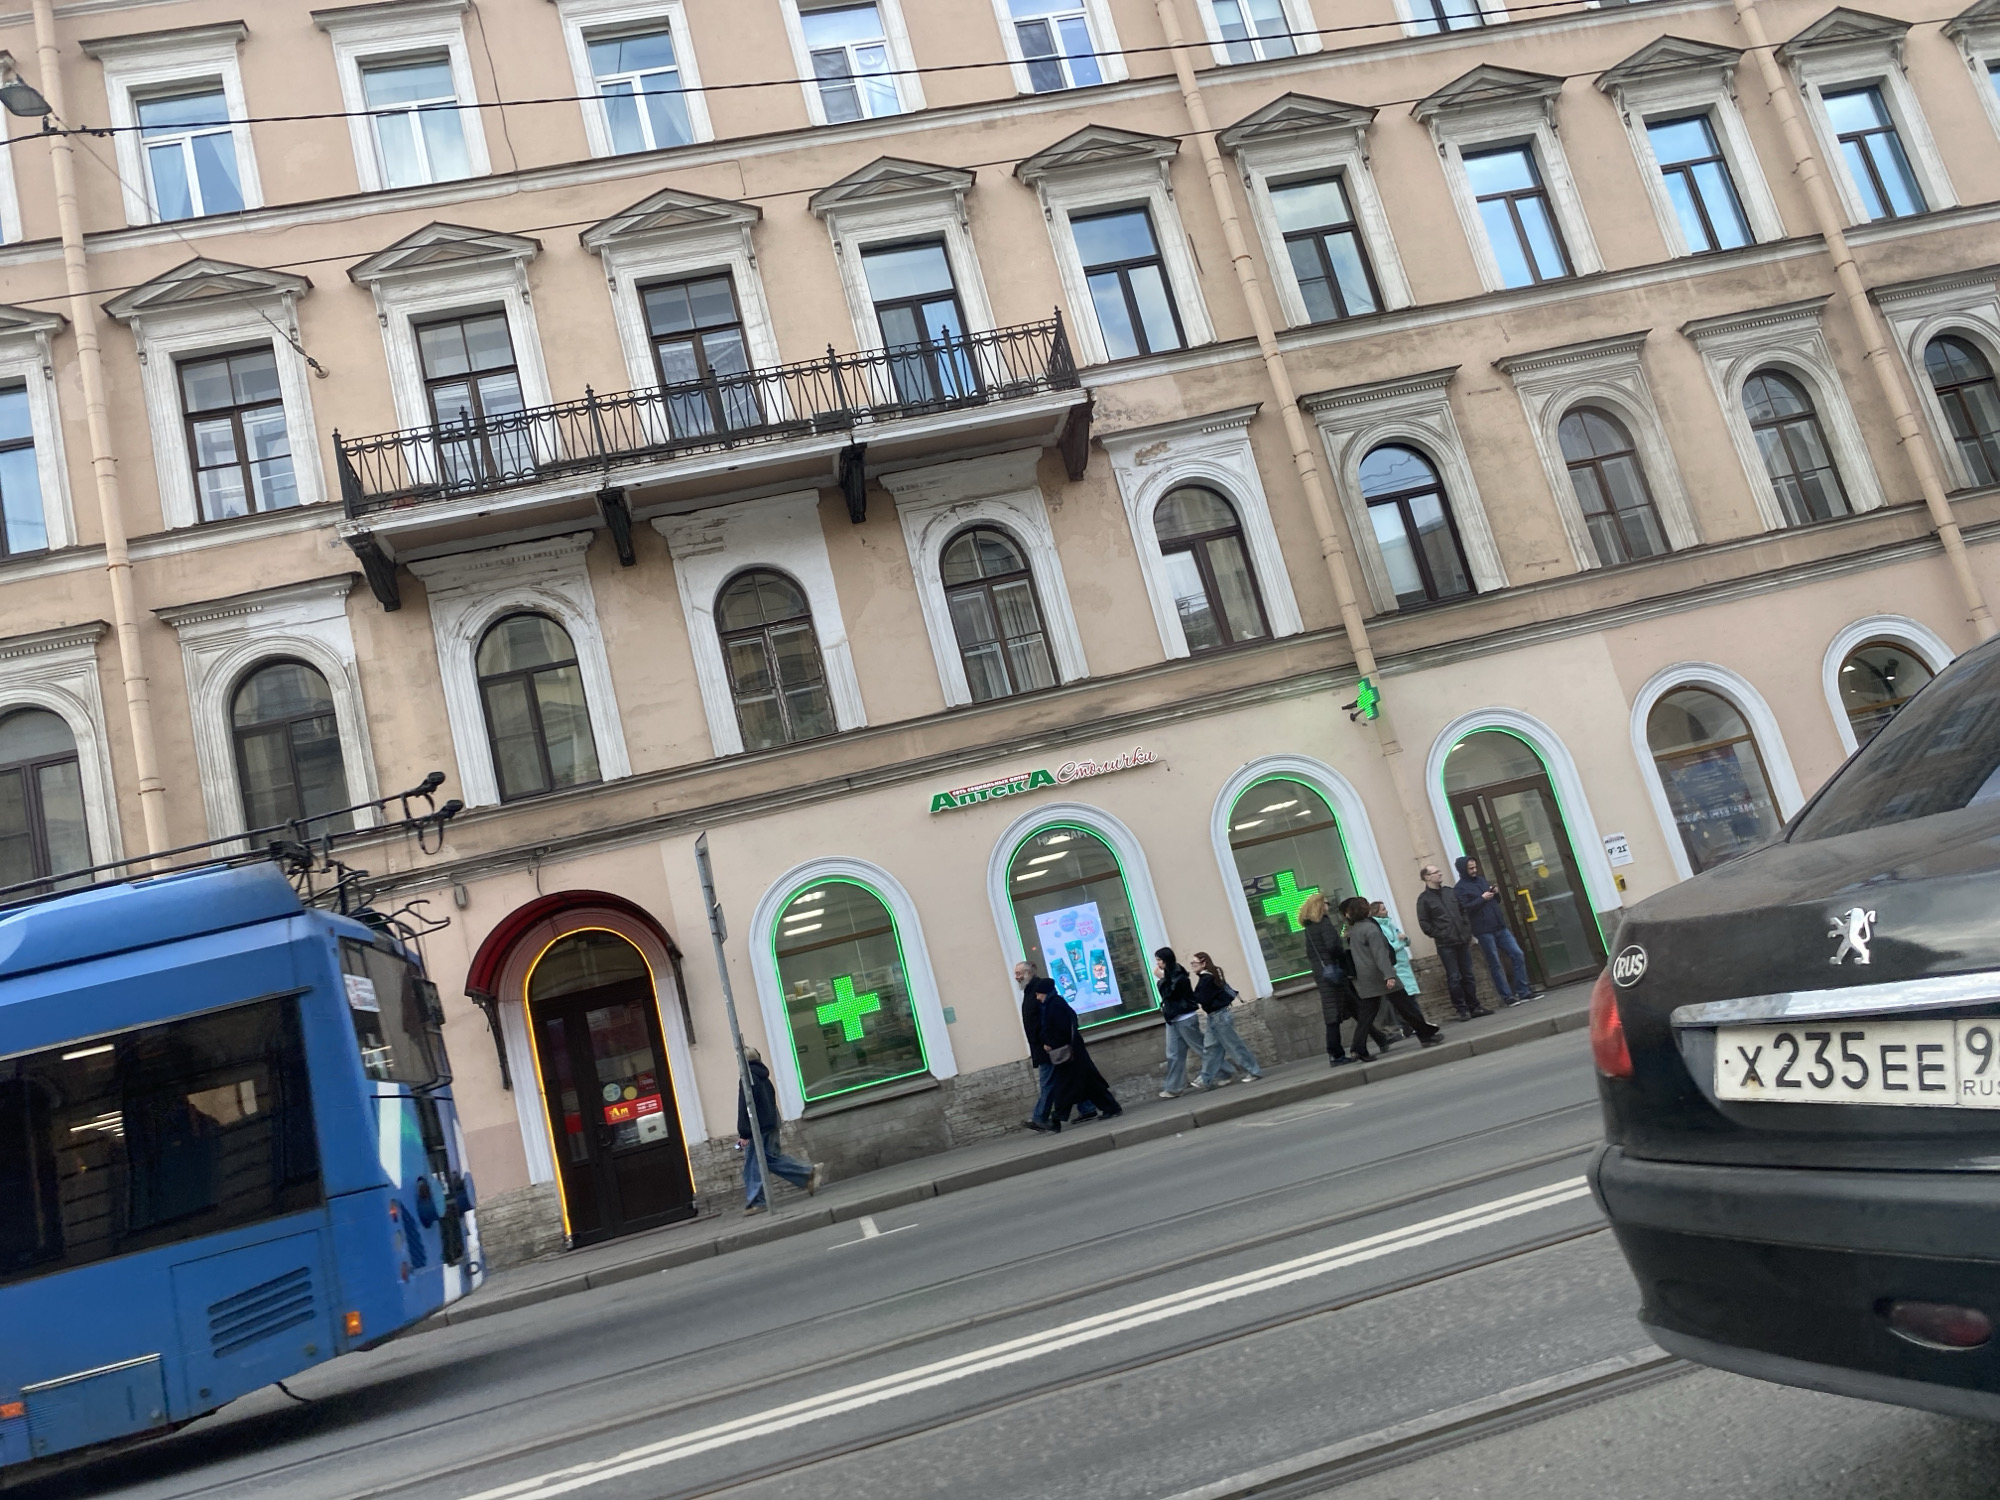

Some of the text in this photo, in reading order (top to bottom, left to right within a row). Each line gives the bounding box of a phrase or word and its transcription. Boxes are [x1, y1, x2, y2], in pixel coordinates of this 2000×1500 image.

[1056, 746, 1158, 784] Столички
[1616, 953, 1644, 979] RUS
[1965, 1026, 2000, 1075] 9
[1963, 1079, 2000, 1096] RU
